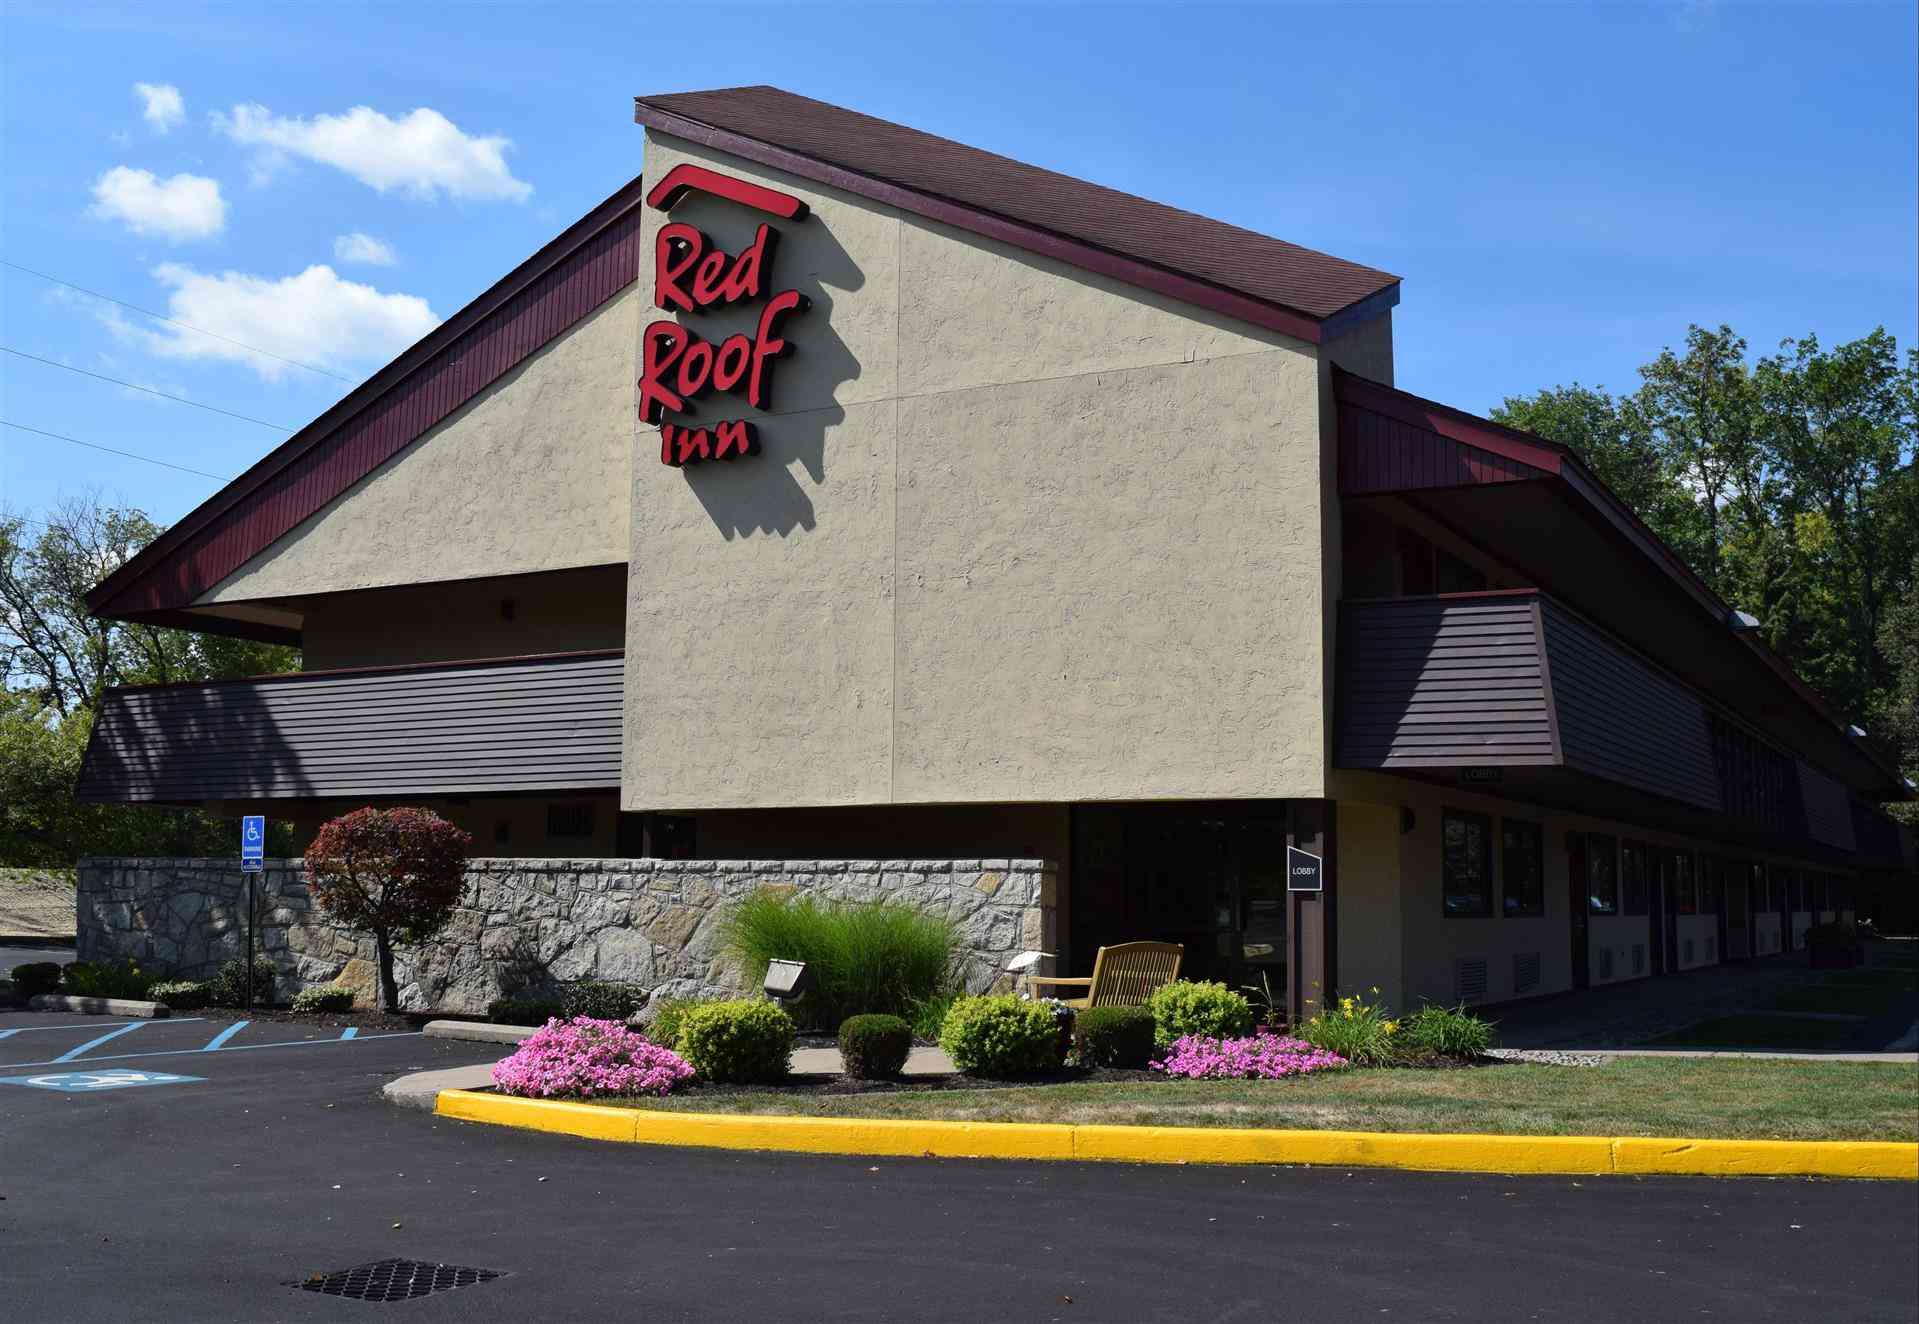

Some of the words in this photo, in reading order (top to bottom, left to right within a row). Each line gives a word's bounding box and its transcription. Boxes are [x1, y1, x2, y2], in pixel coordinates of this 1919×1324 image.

[655, 222, 772, 313] Red
[638, 289, 801, 422] Roof
[661, 419, 752, 466] Inn
[1292, 867, 1315, 875] LOBBY
